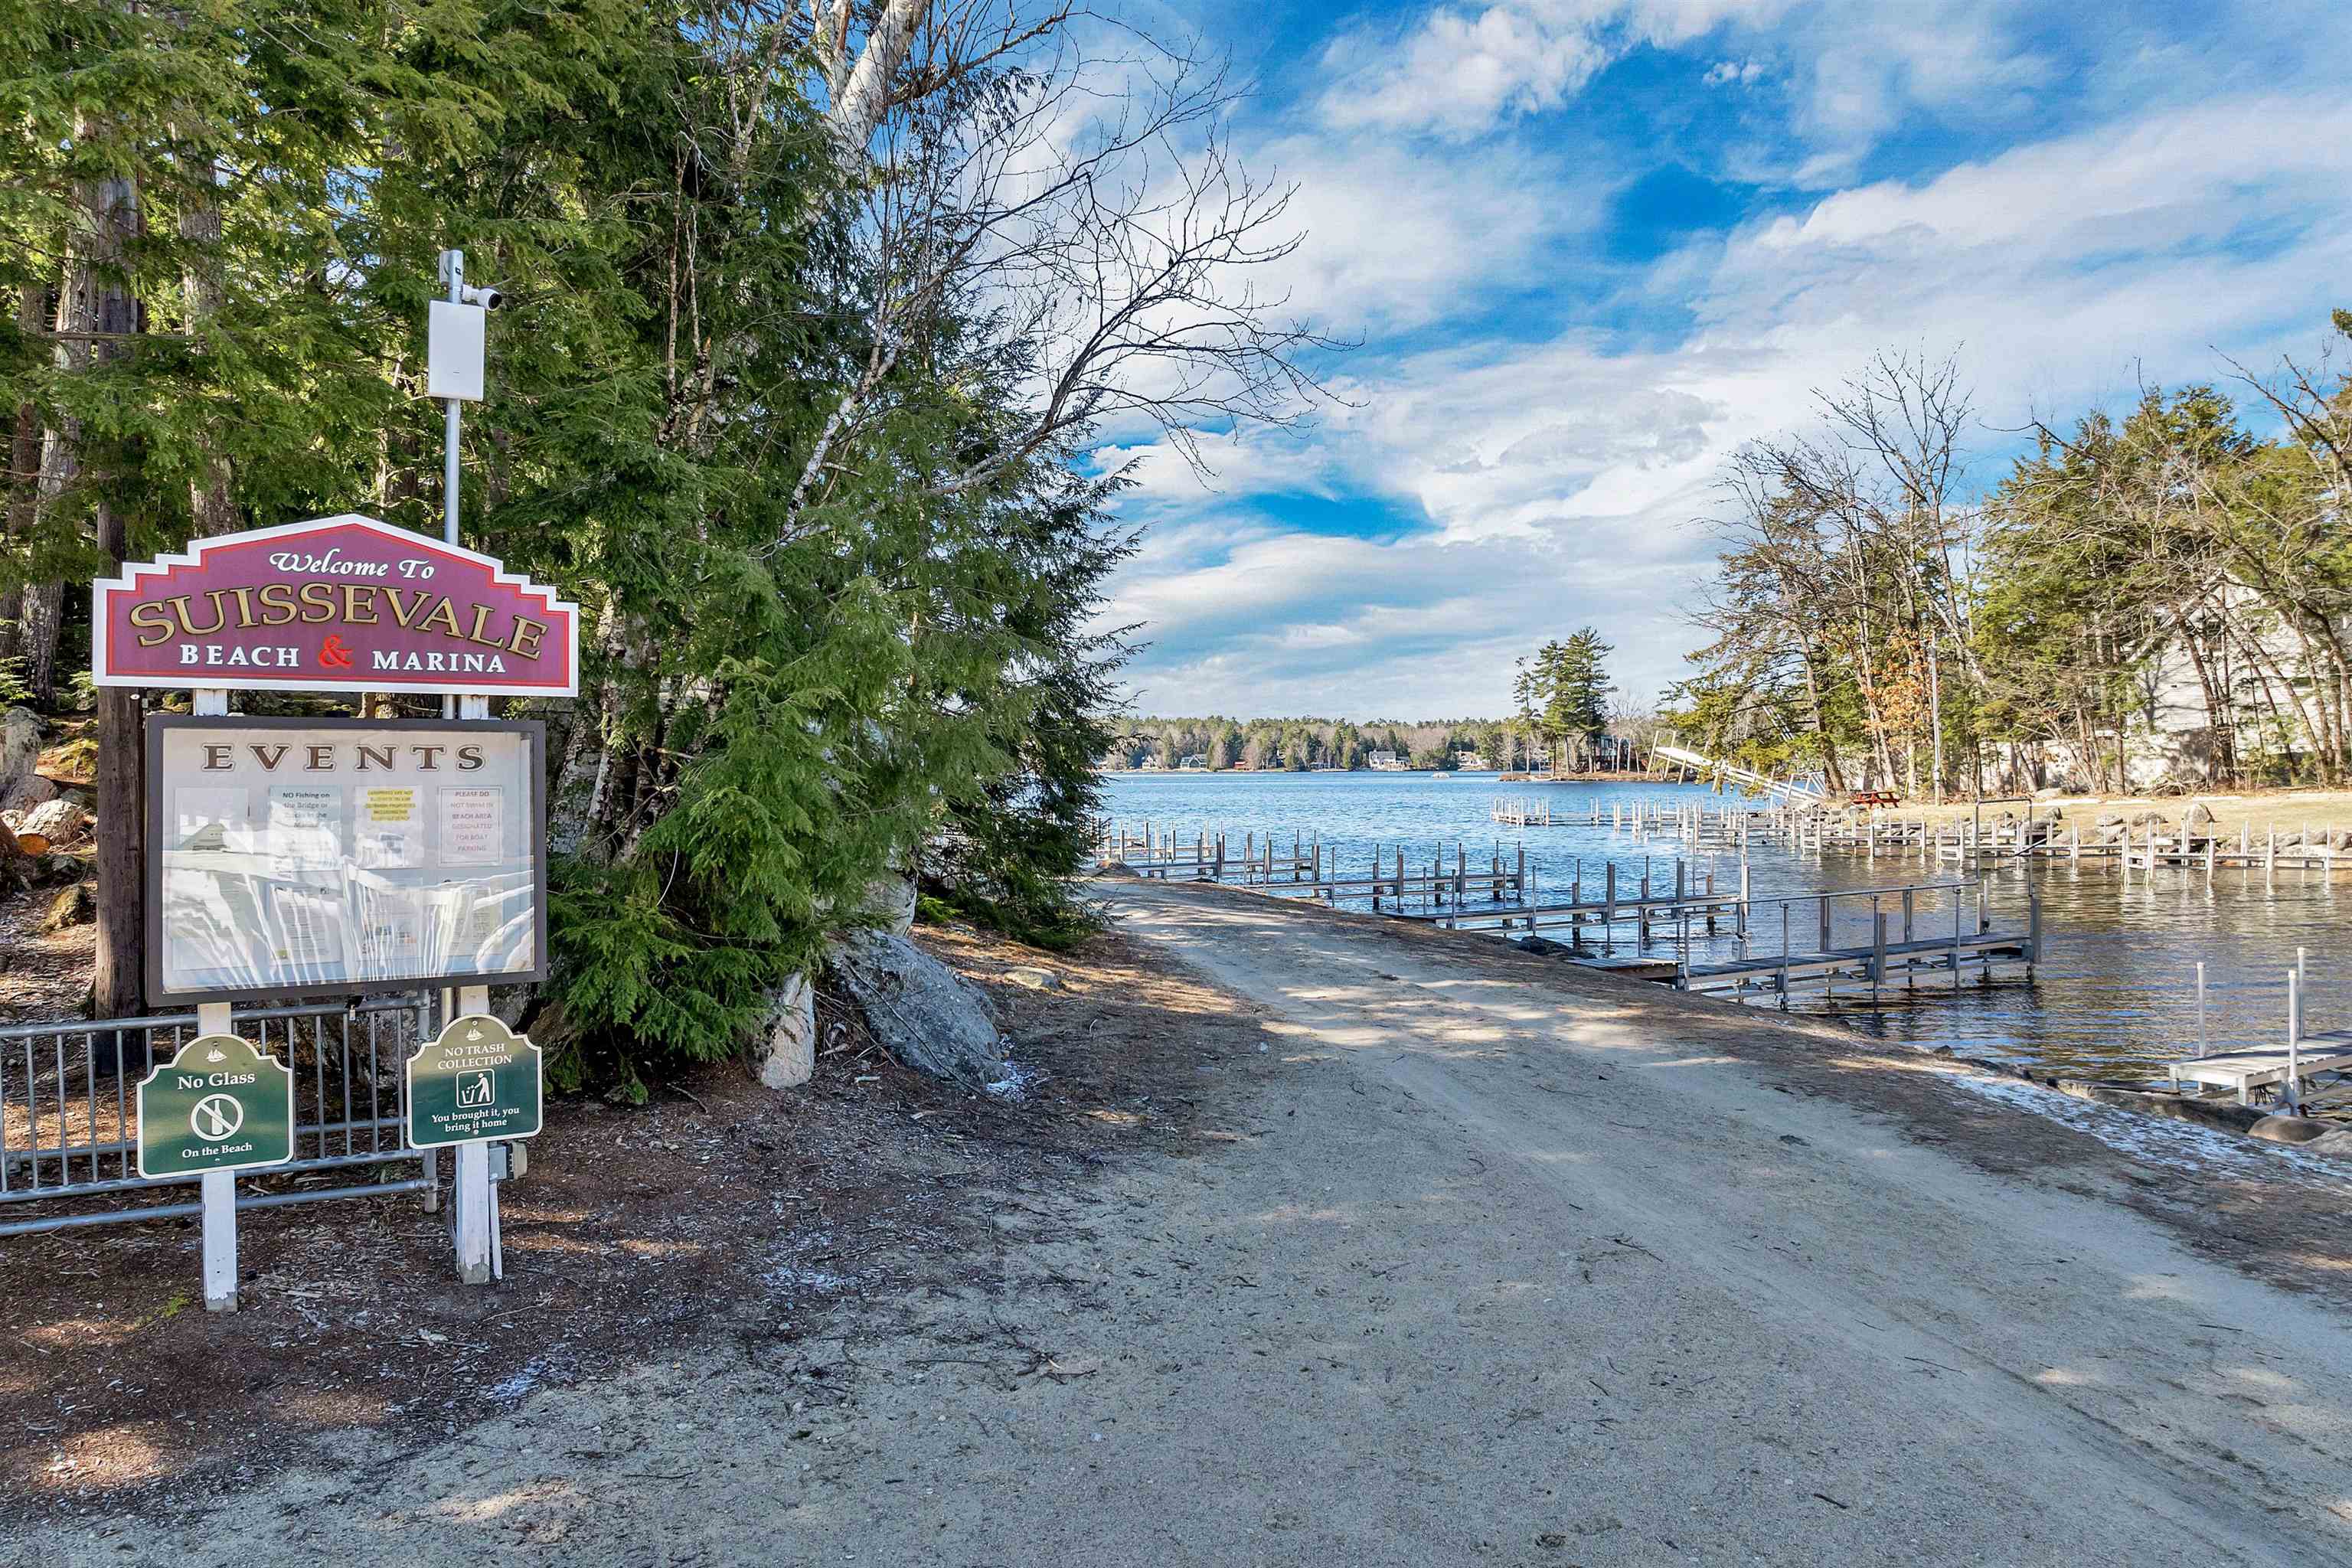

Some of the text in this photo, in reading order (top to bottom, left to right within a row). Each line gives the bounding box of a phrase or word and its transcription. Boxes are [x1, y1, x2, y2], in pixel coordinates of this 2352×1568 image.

[269, 548, 435, 580] Welcome To
[129, 583, 550, 661] SUISSEVALE
[179, 634, 506, 675] BEACH & MARINA
[201, 743, 485, 772] EVENTS
[445, 1043, 505, 1057] NO TRASH
[437, 1054, 513, 1070] COLLECTION
[178, 1071, 256, 1090] No Glass
[432, 1107, 520, 1123] You brought it, you
[445, 1119, 508, 1132] bring it home
[181, 1142, 253, 1158] On the Beach
